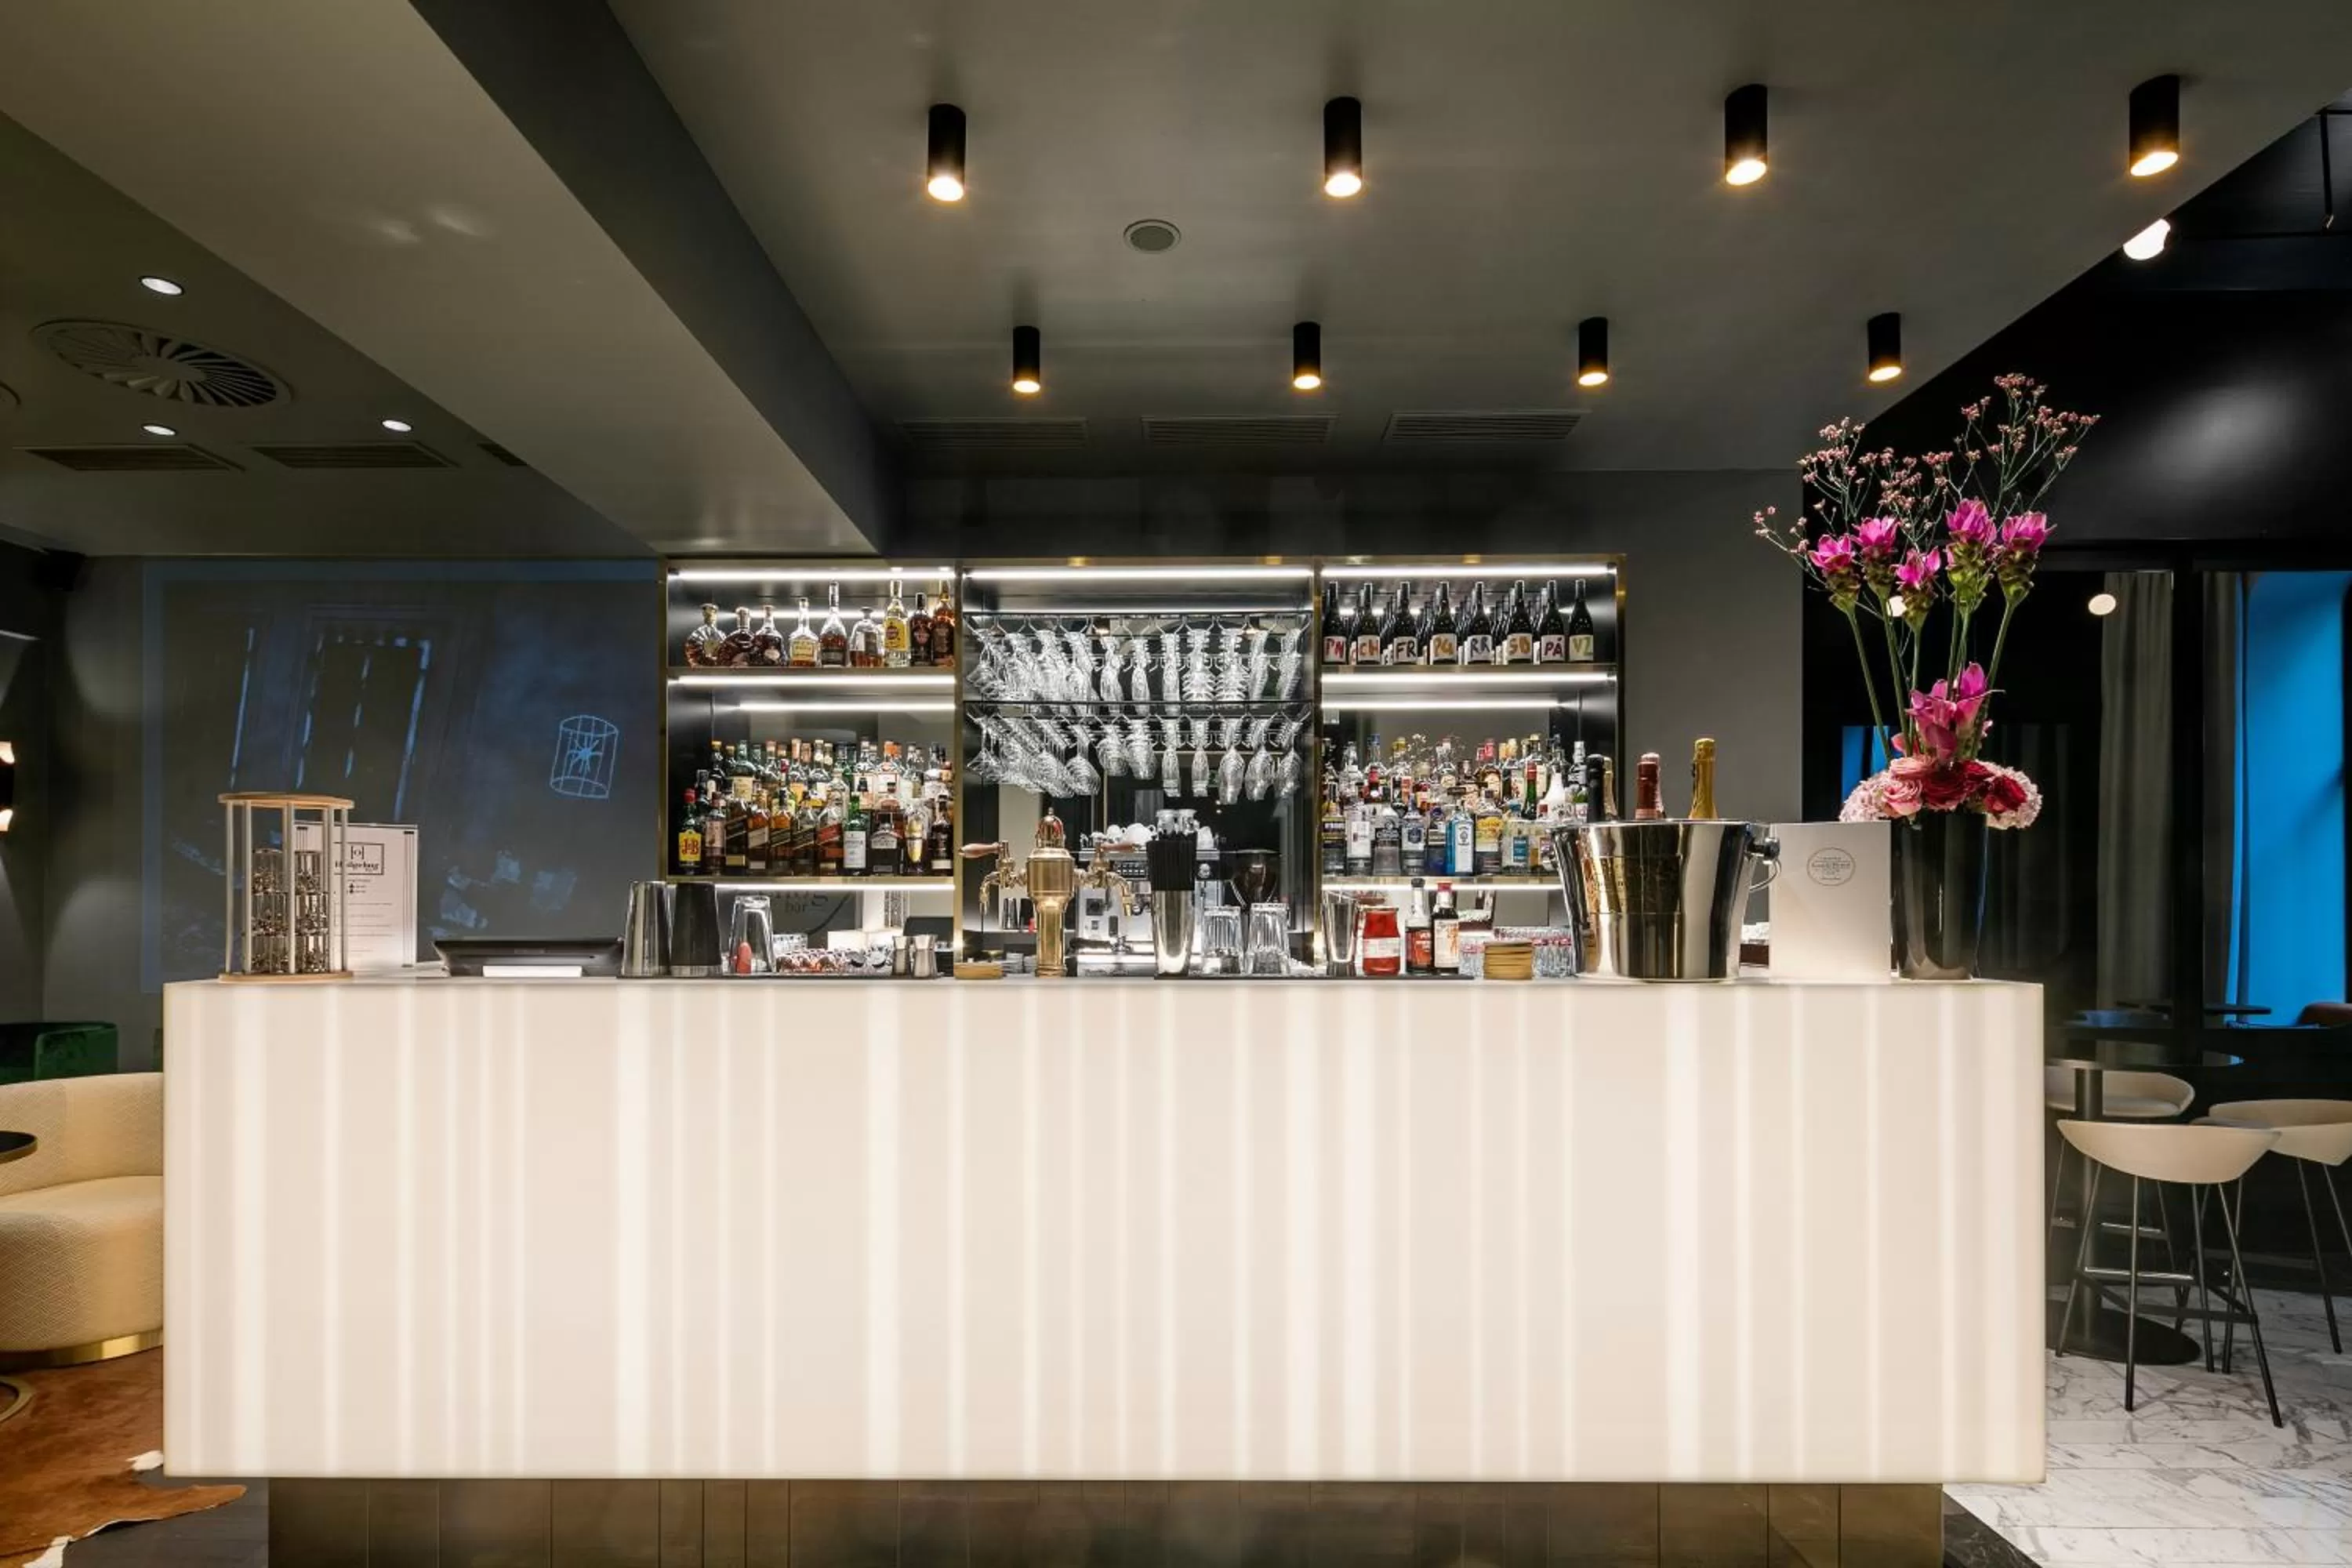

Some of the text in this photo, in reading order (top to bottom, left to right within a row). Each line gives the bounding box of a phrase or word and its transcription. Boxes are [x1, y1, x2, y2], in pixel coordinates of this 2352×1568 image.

[1396, 641, 1417, 659] FR
[1470, 636, 1490, 657] RR
[1544, 637, 1563, 656] PÁ
[1572, 637, 1593, 655] VZ
